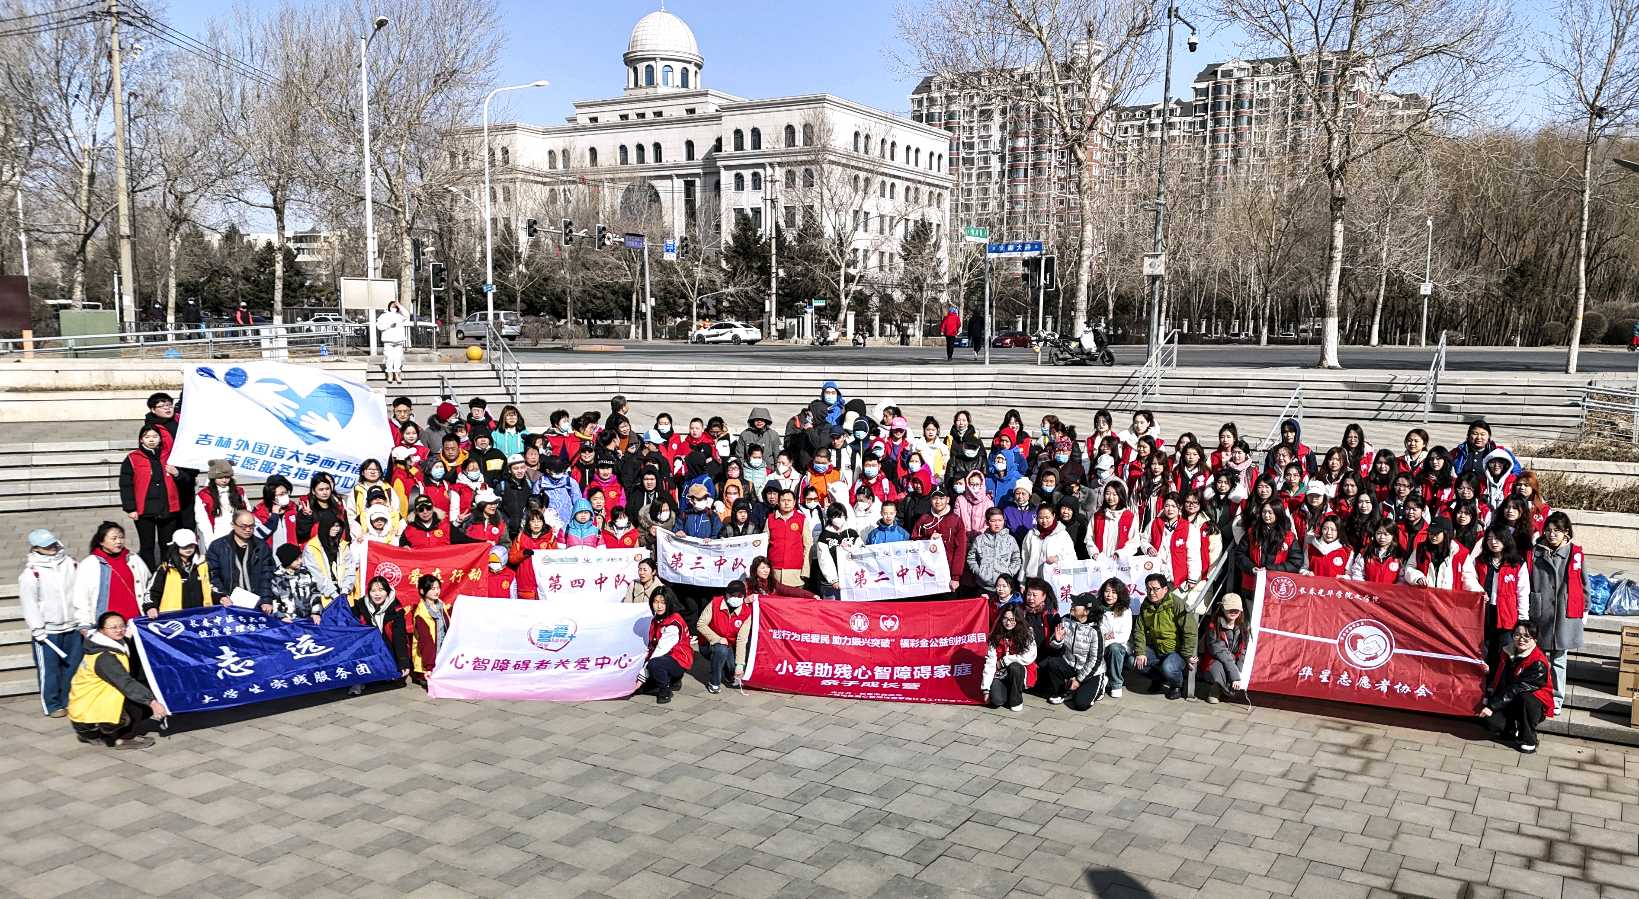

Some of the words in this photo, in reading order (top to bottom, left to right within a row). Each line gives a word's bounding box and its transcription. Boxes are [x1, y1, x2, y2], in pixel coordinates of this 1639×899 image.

[194, 433, 388, 477] 吉林外国语大学西方语
[671, 551, 747, 573] 第三中队
[548, 572, 631, 592] 第四中队
[854, 565, 935, 588] 第二中队
[900, 632, 987, 648] 福彩金公益创投项目
[449, 653, 633, 672] 心智障碍者关爱中心
[774, 659, 973, 681] 小爱助残心智障碍家庭
[201, 663, 372, 704] 大学生实践服务团
[820, 679, 921, 691] 亲子成长营
[1298, 665, 1434, 698] 华星志愿者协会
